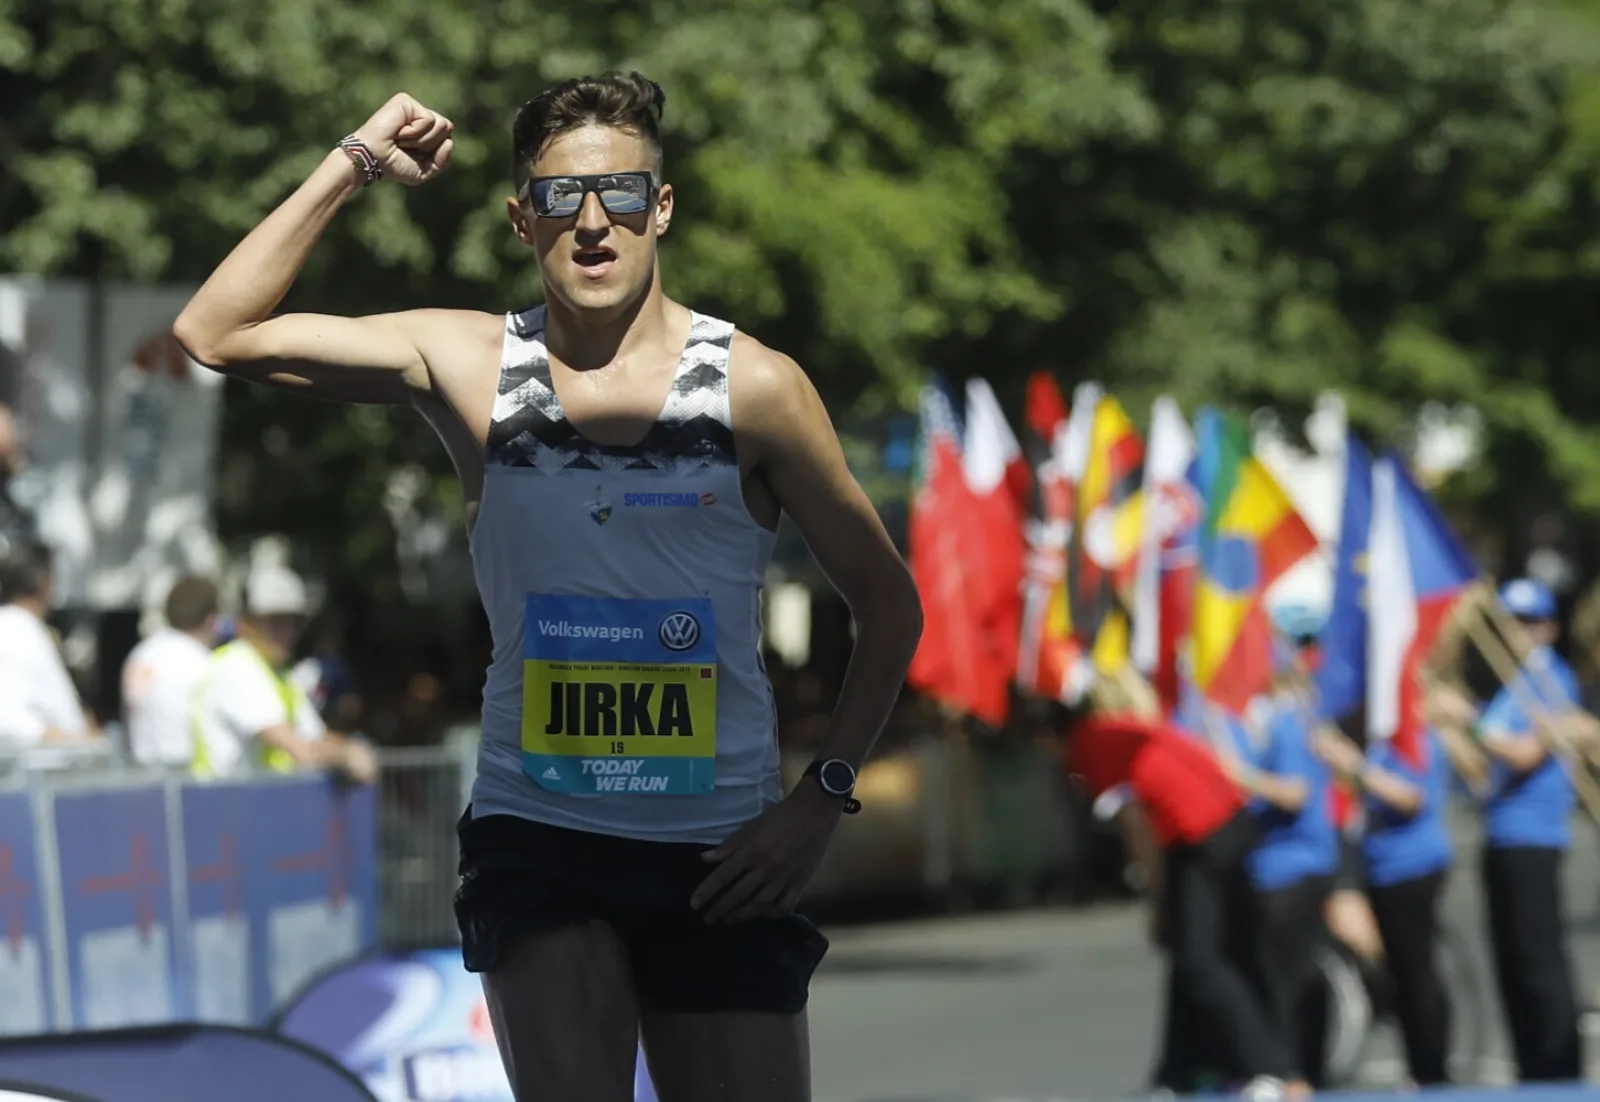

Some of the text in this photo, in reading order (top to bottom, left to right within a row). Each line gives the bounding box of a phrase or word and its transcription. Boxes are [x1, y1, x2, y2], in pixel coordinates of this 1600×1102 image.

[624, 492, 699, 507] SPORTISIMO
[538, 620, 644, 642] Volkswagen
[545, 681, 694, 736] JIRKA
[610, 741, 625, 755] 19
[581, 759, 645, 775] TODAY
[596, 777, 669, 791] WE RUN
